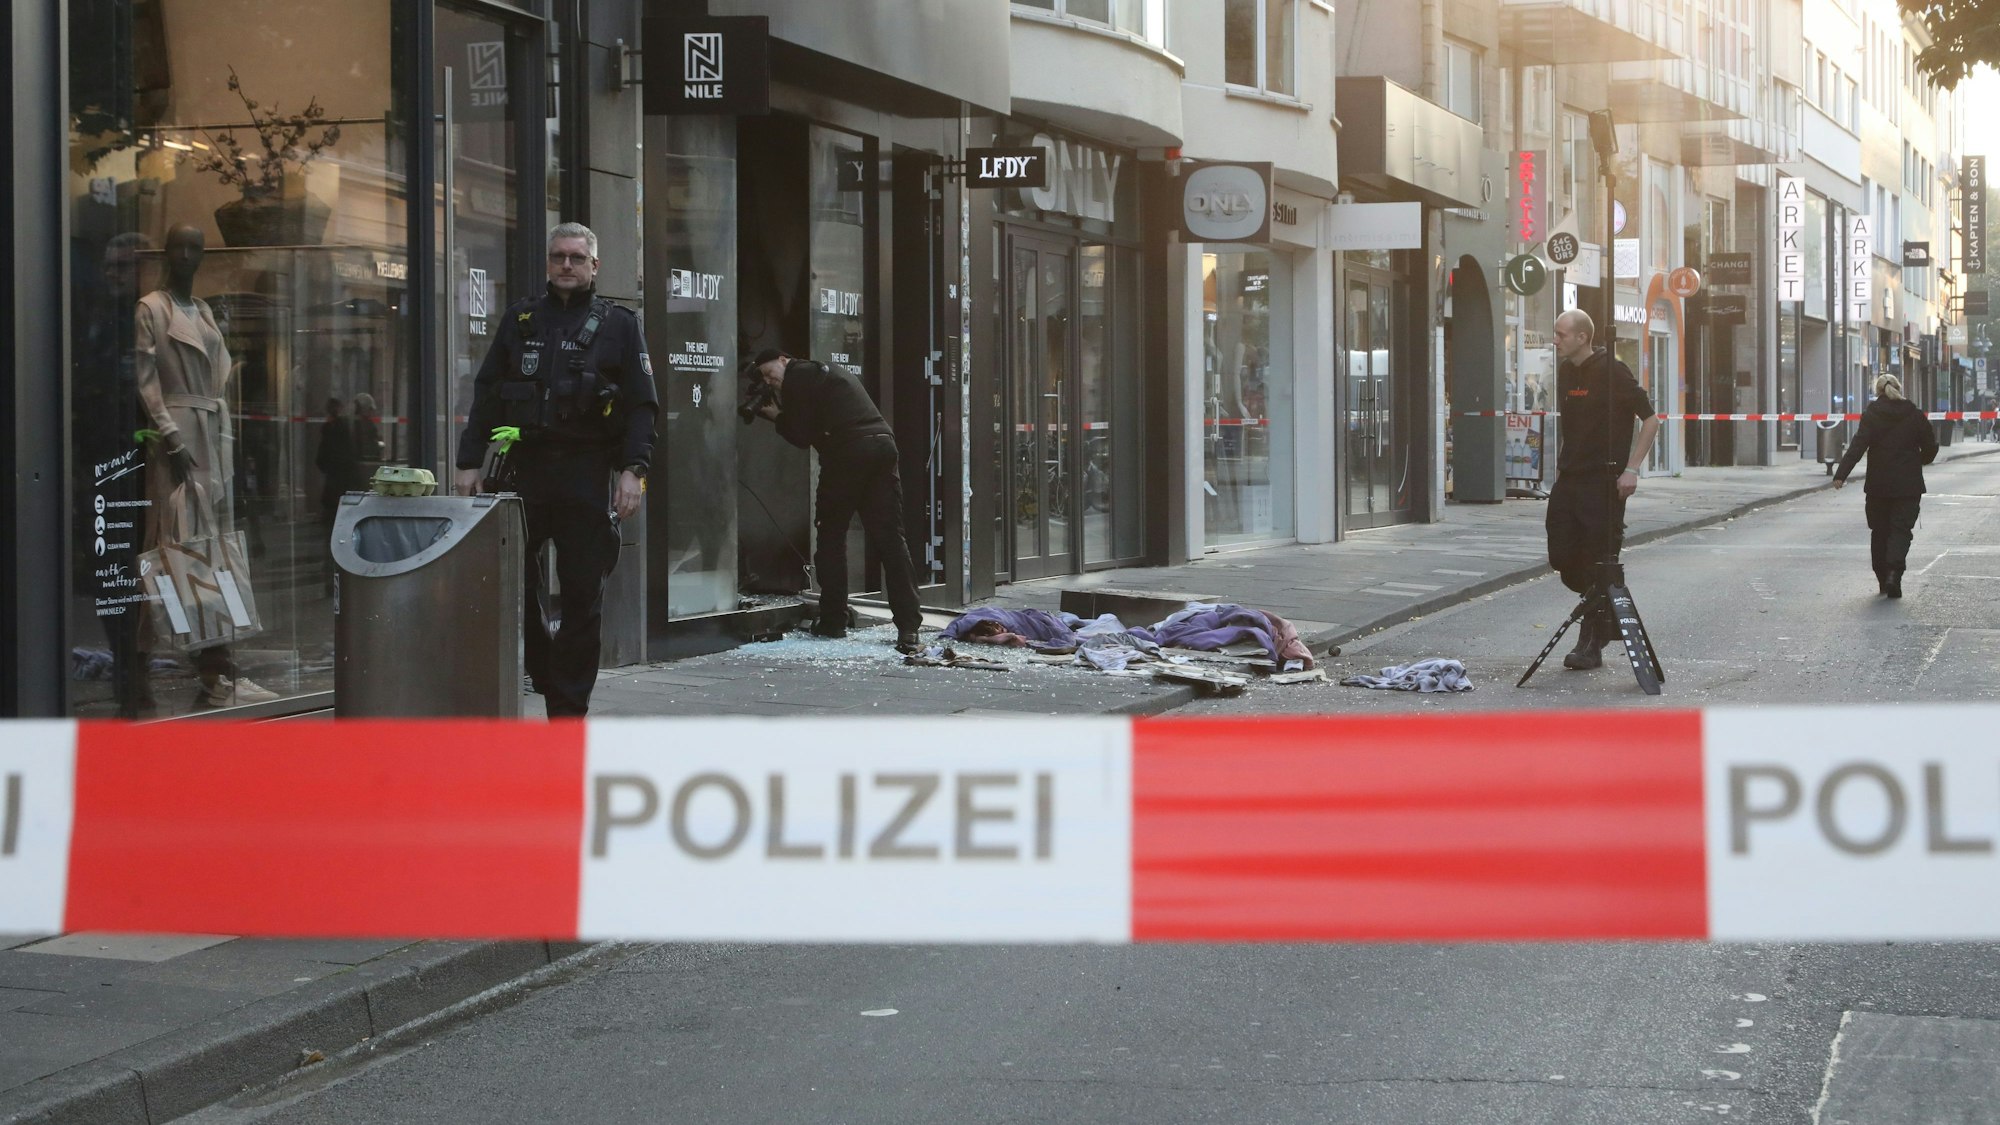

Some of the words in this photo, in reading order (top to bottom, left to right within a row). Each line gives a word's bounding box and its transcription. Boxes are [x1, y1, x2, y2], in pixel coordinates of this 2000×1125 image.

[684, 84, 723, 98] NILE
[1969, 158, 1979, 186] SON
[1188, 192, 1255, 214] ONLY
[1970, 191, 1979, 200] &
[1784, 181, 1799, 298] ARKET
[1969, 205, 1979, 257] KAPTEN
[1854, 219, 1867, 318] ARKET
[470, 320, 487, 335] NILE
[685, 341, 696, 352] THE
[696, 342, 708, 353] NEW
[669, 353, 693, 365] CAPSULE
[693, 354, 724, 366] COLLECTION
[831, 352, 840, 362] THE
[840, 353, 849, 363] NEW
[590, 771, 1054, 862] POLIZEI
